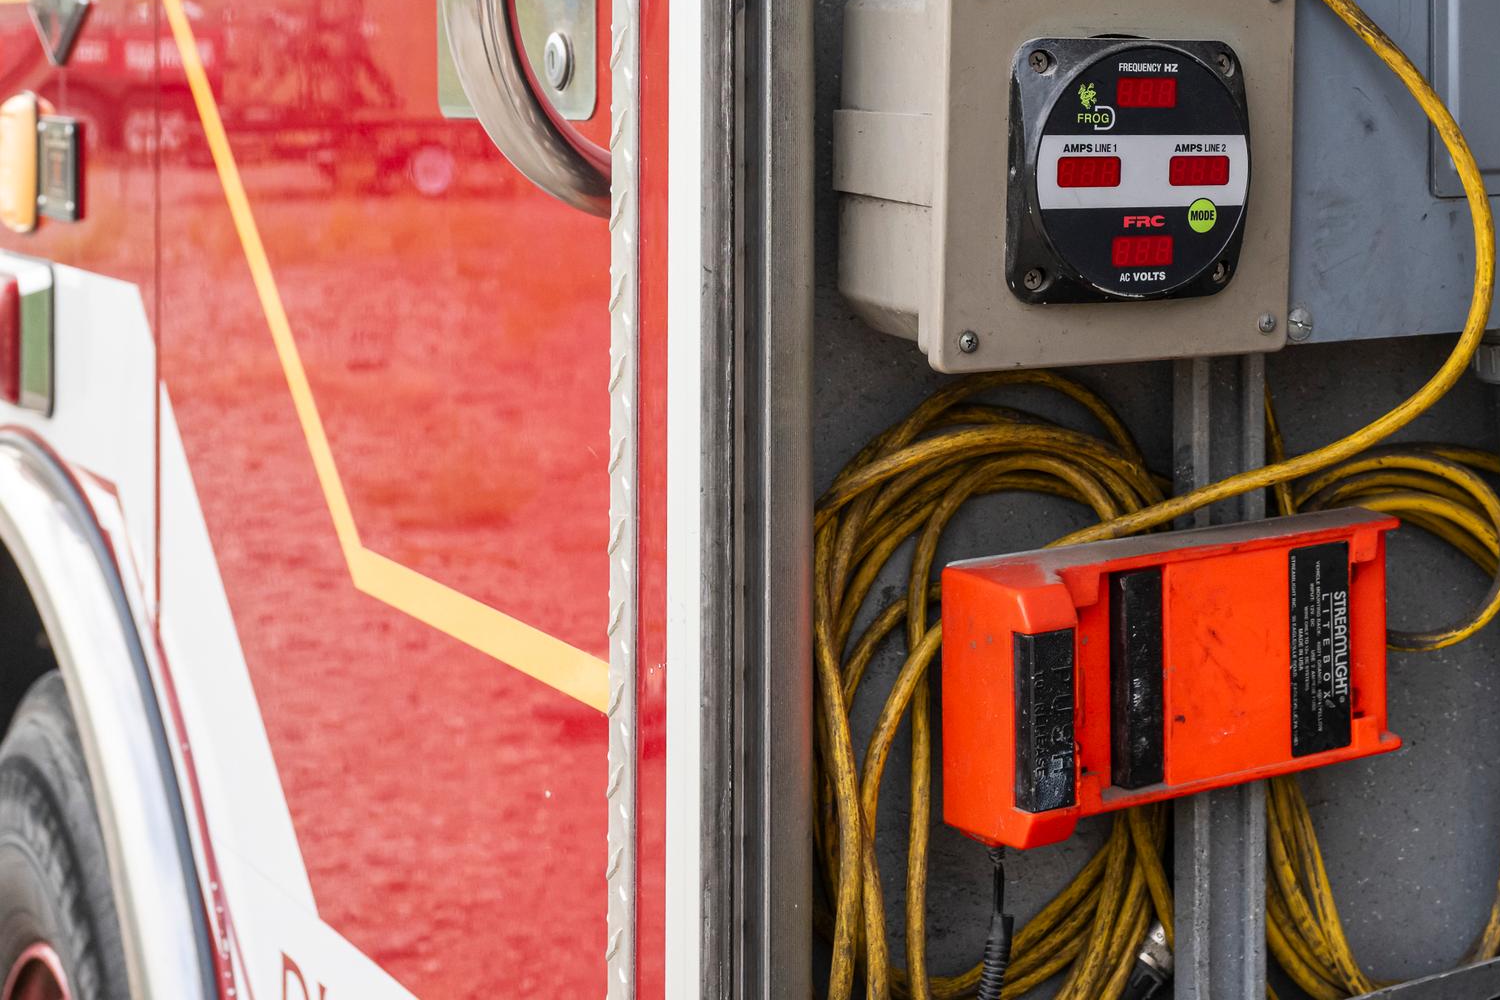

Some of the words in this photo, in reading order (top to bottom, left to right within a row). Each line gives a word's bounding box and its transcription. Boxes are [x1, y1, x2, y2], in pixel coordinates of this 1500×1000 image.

[1118, 62, 1162, 72] FREQUENCY
[1164, 64, 1179, 73] HZ
[1077, 113, 1110, 124] FROG
[1063, 143, 1093, 153] AMPS
[1094, 143, 1111, 153] LINE
[1113, 143, 1117, 153] 1
[1174, 143, 1203, 153] AMPS
[1204, 143, 1219, 153] LINE
[1220, 143, 1226, 153] 2
[1190, 210, 1215, 221] MODE
[1123, 215, 1165, 228] FRC
[1119, 272, 1131, 282] AC
[1133, 271, 1166, 281] VOLTS
[1334, 591, 1348, 695] STREAMLIGHT
[1298, 648, 1304, 656] IN
